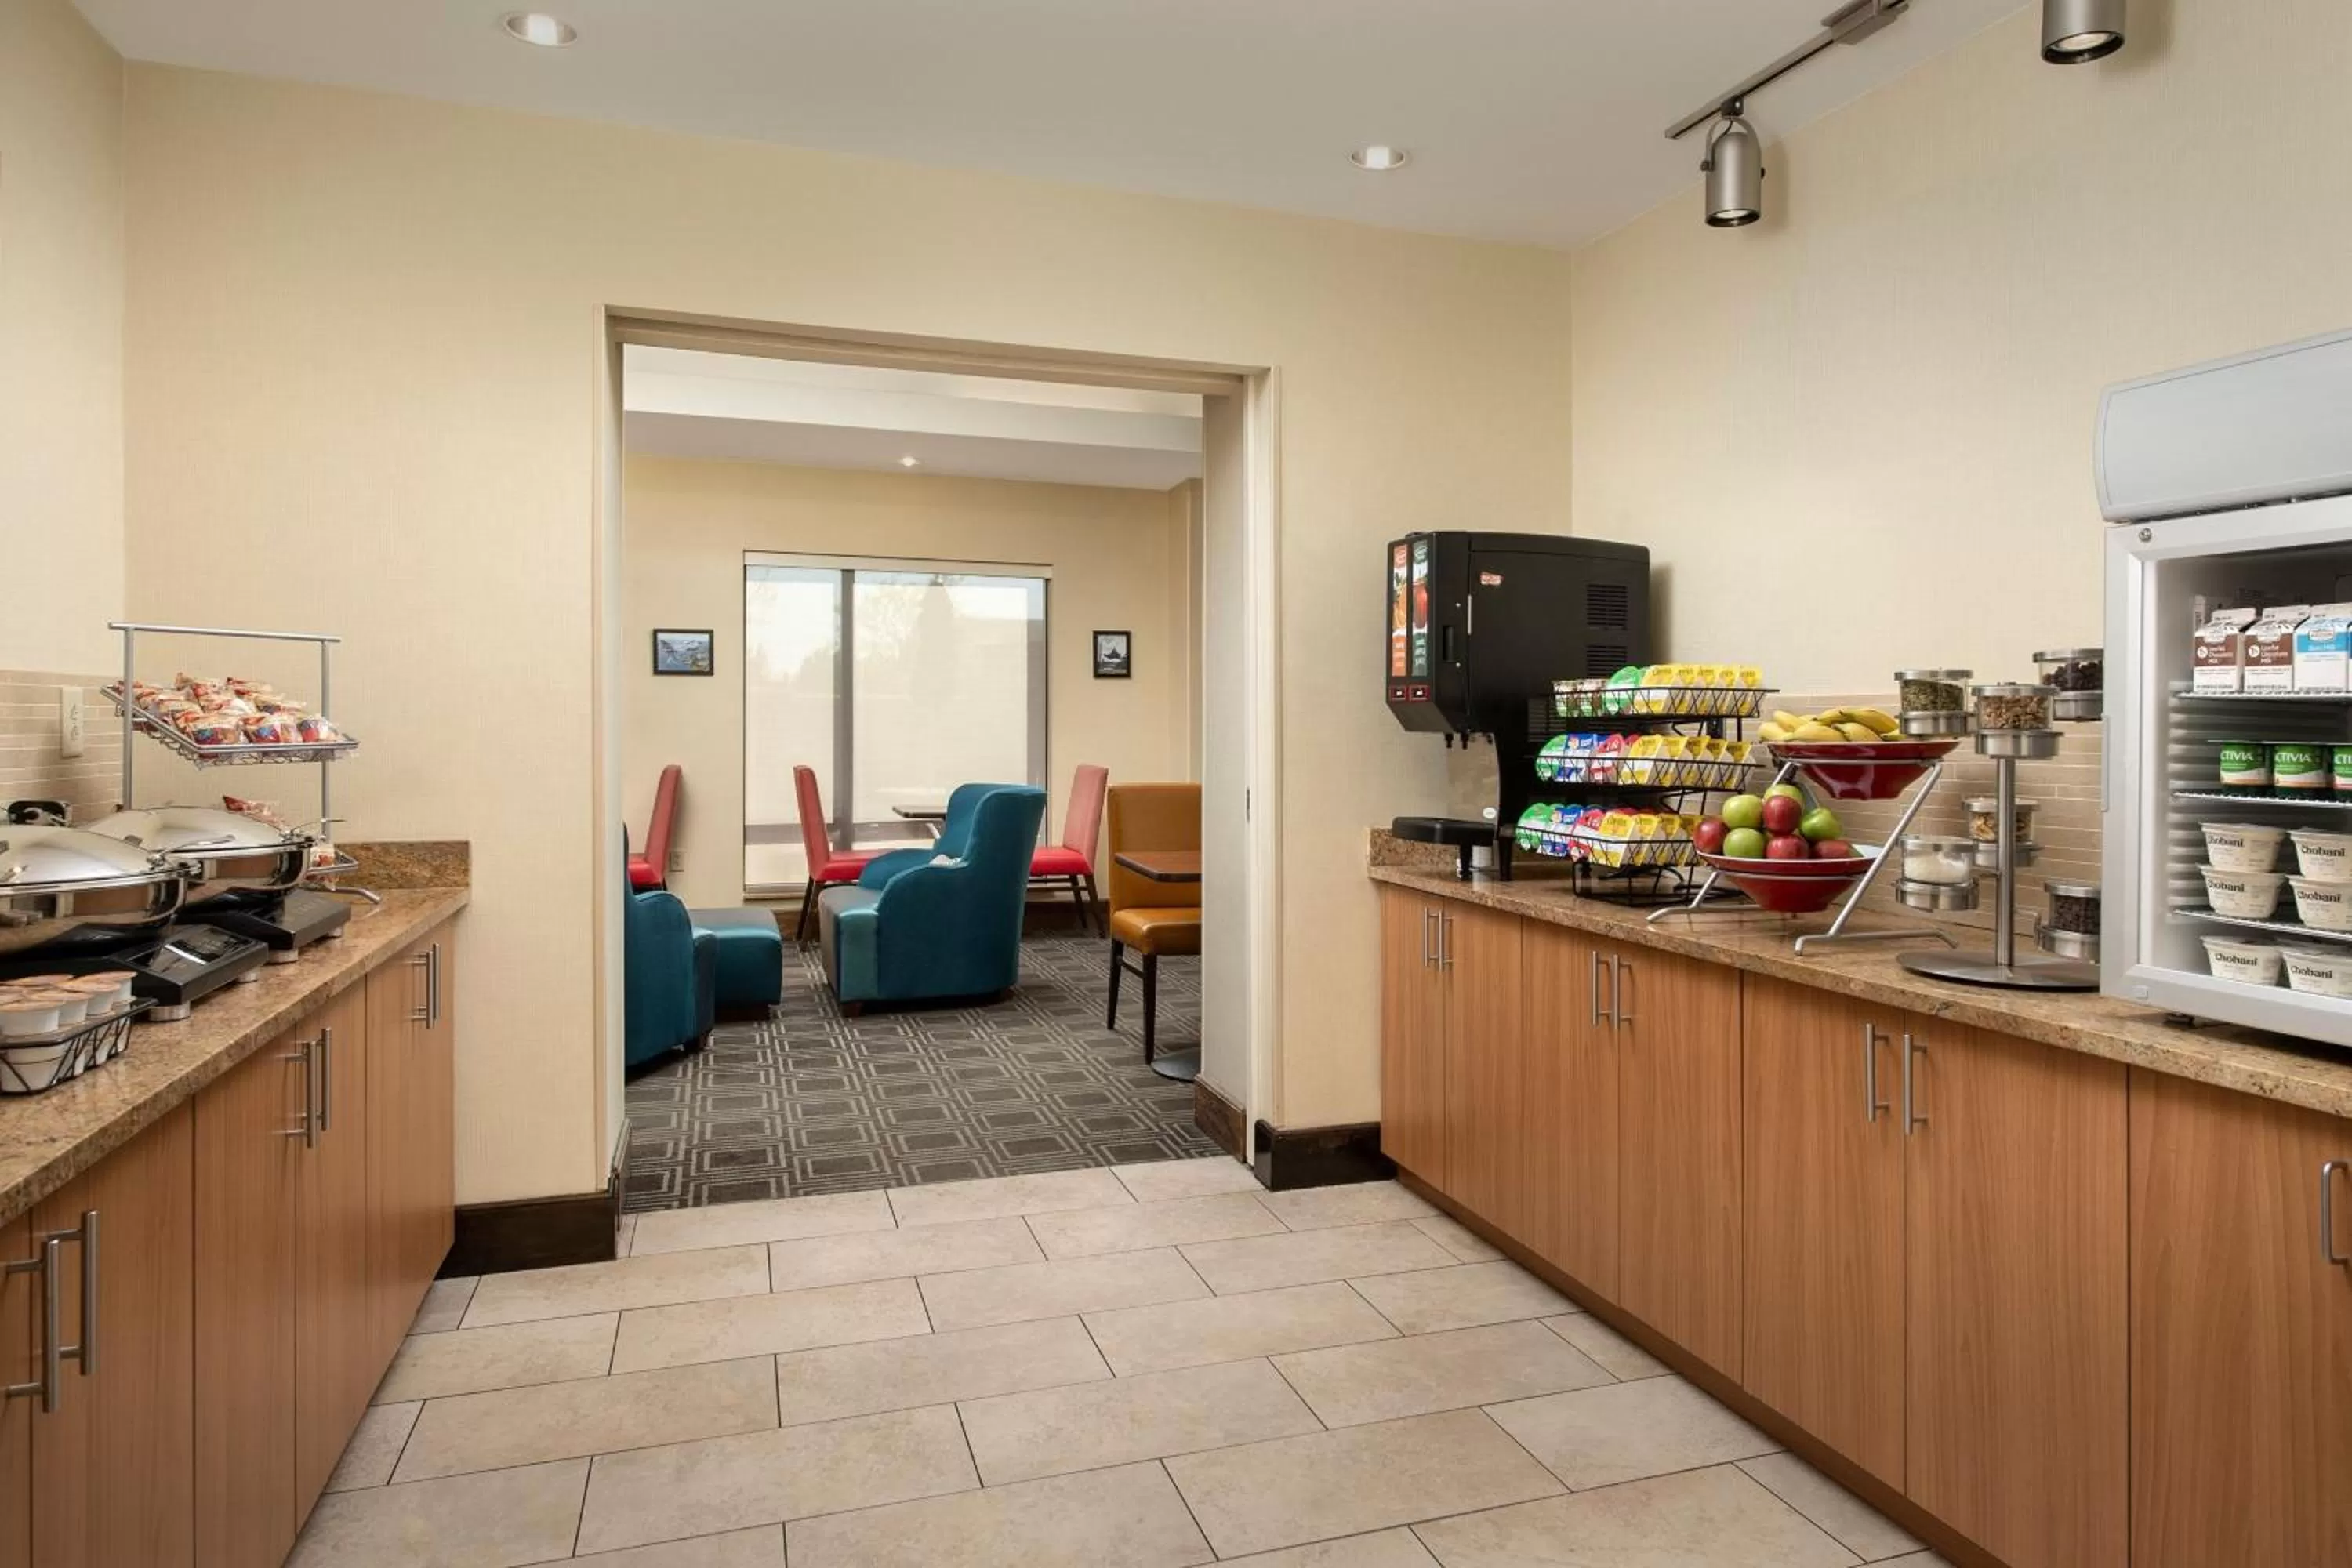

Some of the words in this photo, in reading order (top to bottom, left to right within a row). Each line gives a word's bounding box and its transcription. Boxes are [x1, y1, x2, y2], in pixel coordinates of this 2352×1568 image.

[2220, 750, 2254, 761] CTIVIA
[2275, 752, 2312, 763] CTIVIA
[2301, 844, 2346, 857] Chobani
[2208, 879, 2245, 892] Chobani
[2297, 890, 2342, 903] Chobani
[2214, 952, 2258, 967] Chobani
[2291, 965, 2333, 979] Chobani
